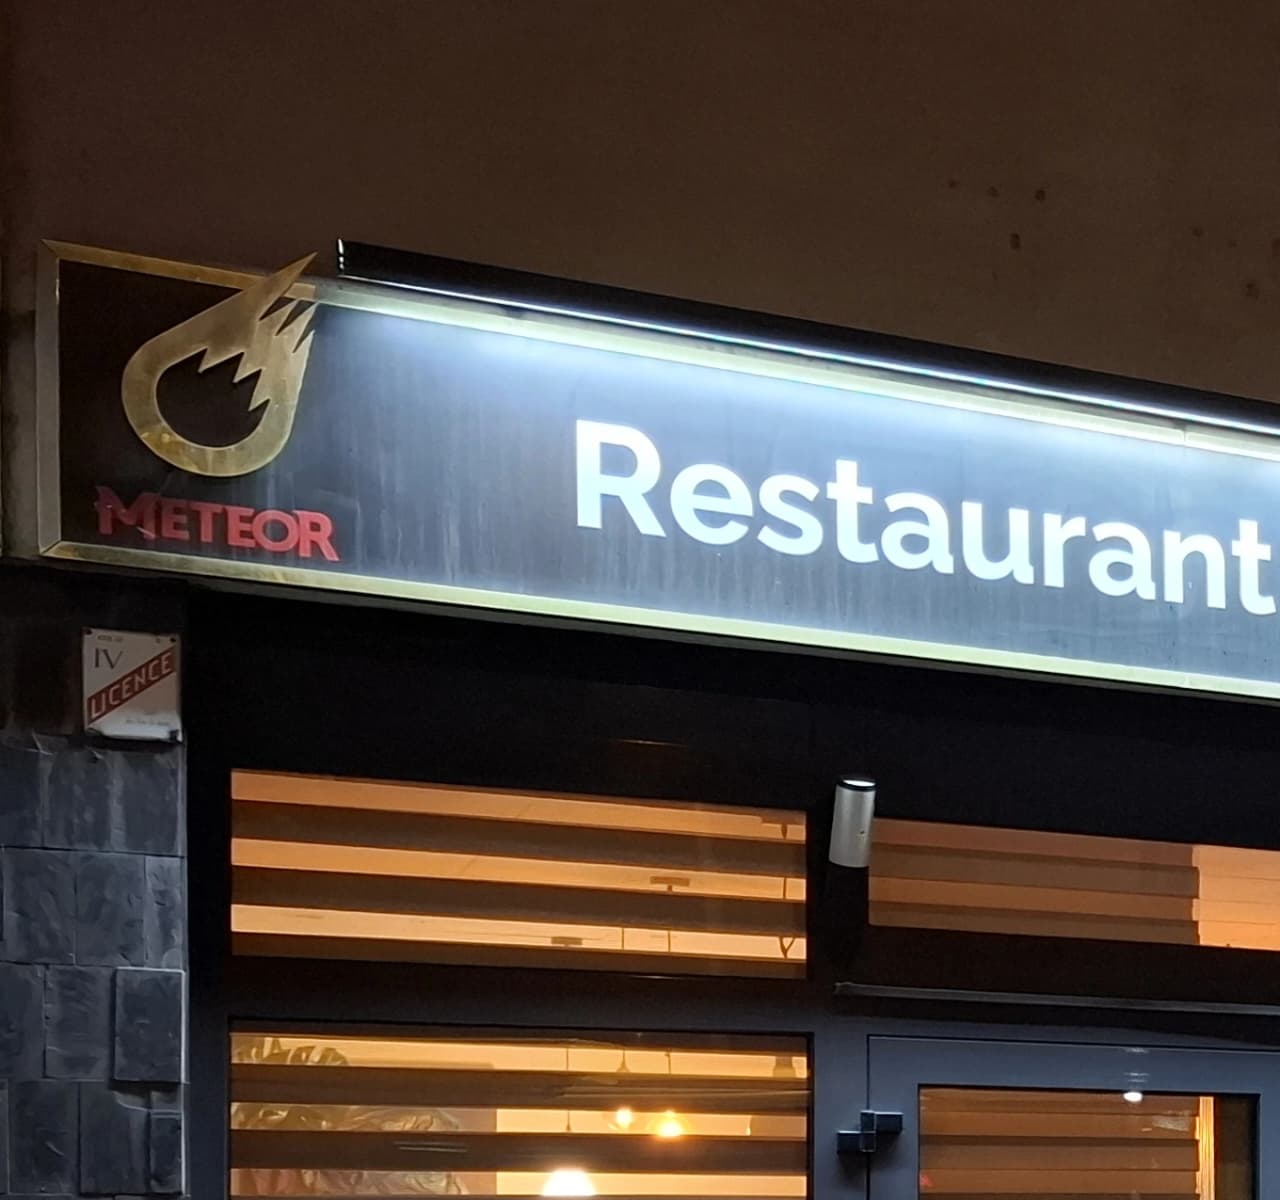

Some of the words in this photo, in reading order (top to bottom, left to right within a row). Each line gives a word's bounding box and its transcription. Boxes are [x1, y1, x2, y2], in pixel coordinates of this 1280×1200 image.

[95, 486, 340, 561] METEOR
[575, 419, 1276, 616] Restaurant
[90, 651, 173, 719] LICENCE
[95, 648, 122, 669] IV
